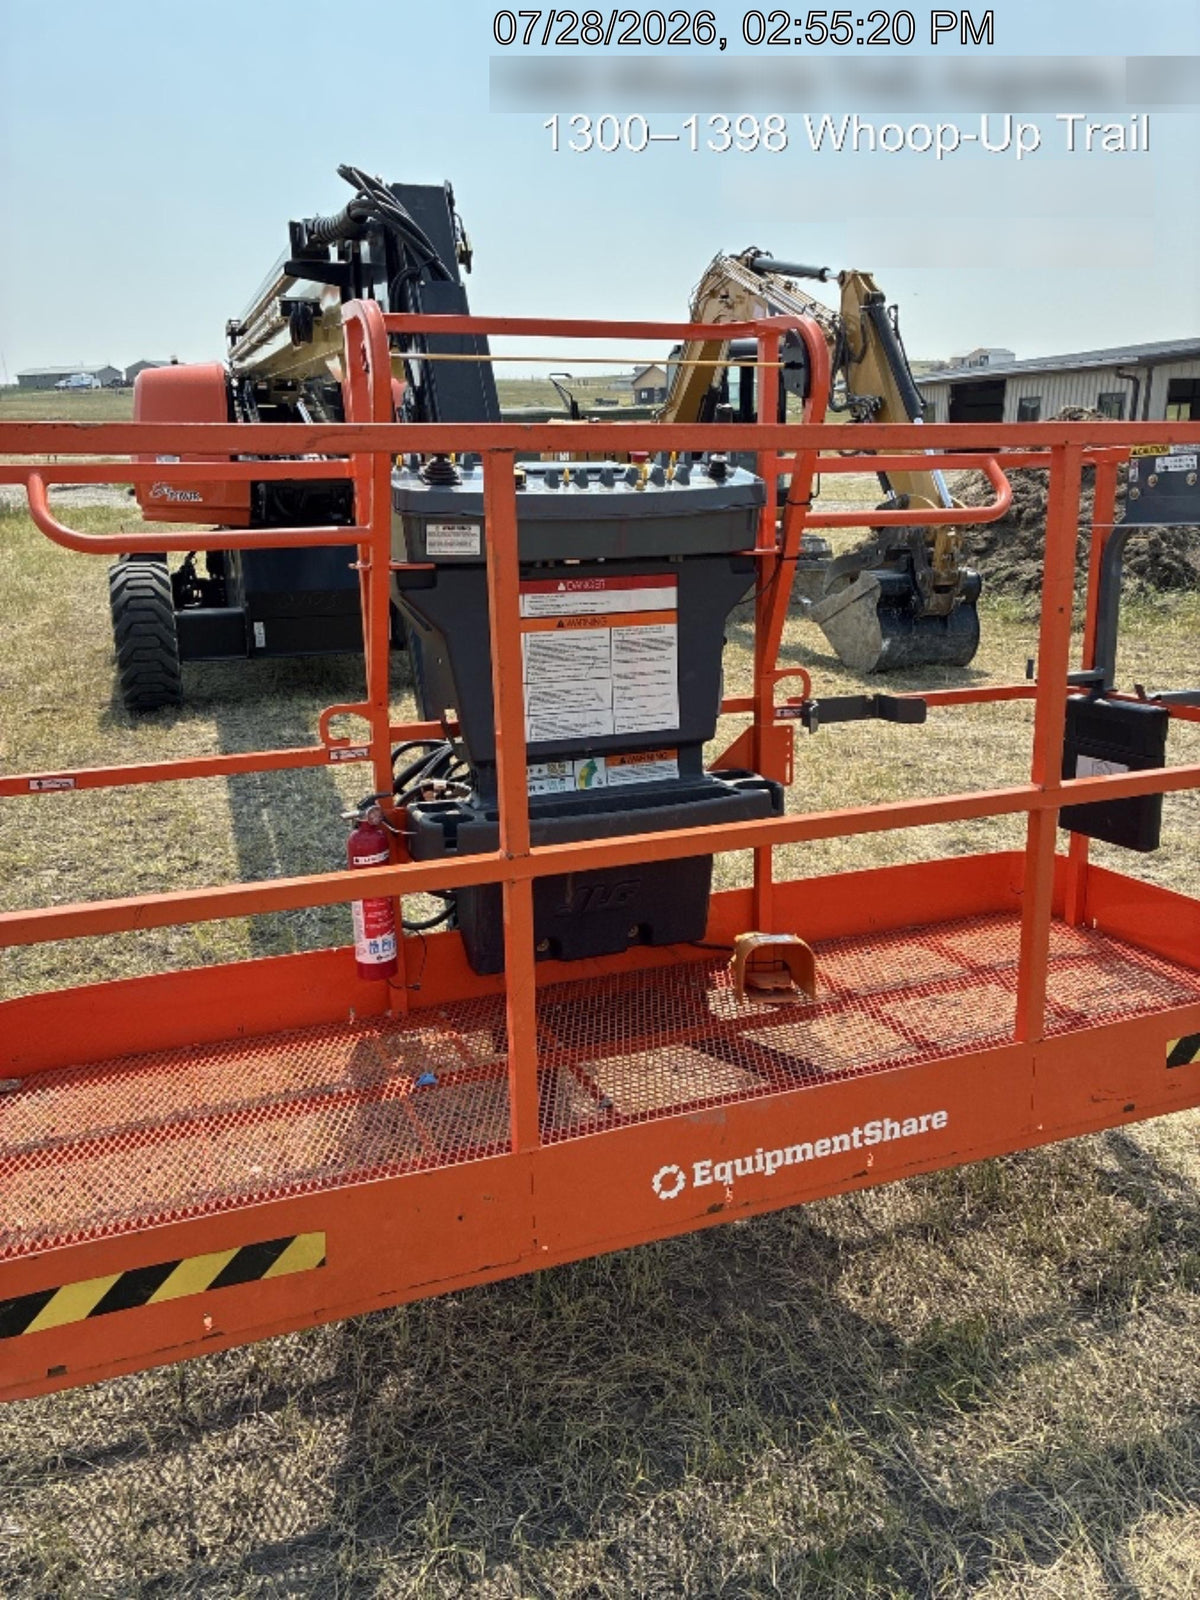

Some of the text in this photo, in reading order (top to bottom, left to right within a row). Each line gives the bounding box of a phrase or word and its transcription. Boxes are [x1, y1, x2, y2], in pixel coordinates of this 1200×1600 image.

[566, 579, 606, 591] DANGER
[566, 616, 608, 627] WARNING
[626, 751, 668, 765] WARNING
[692, 1110, 948, 1188] EquipmentShare
